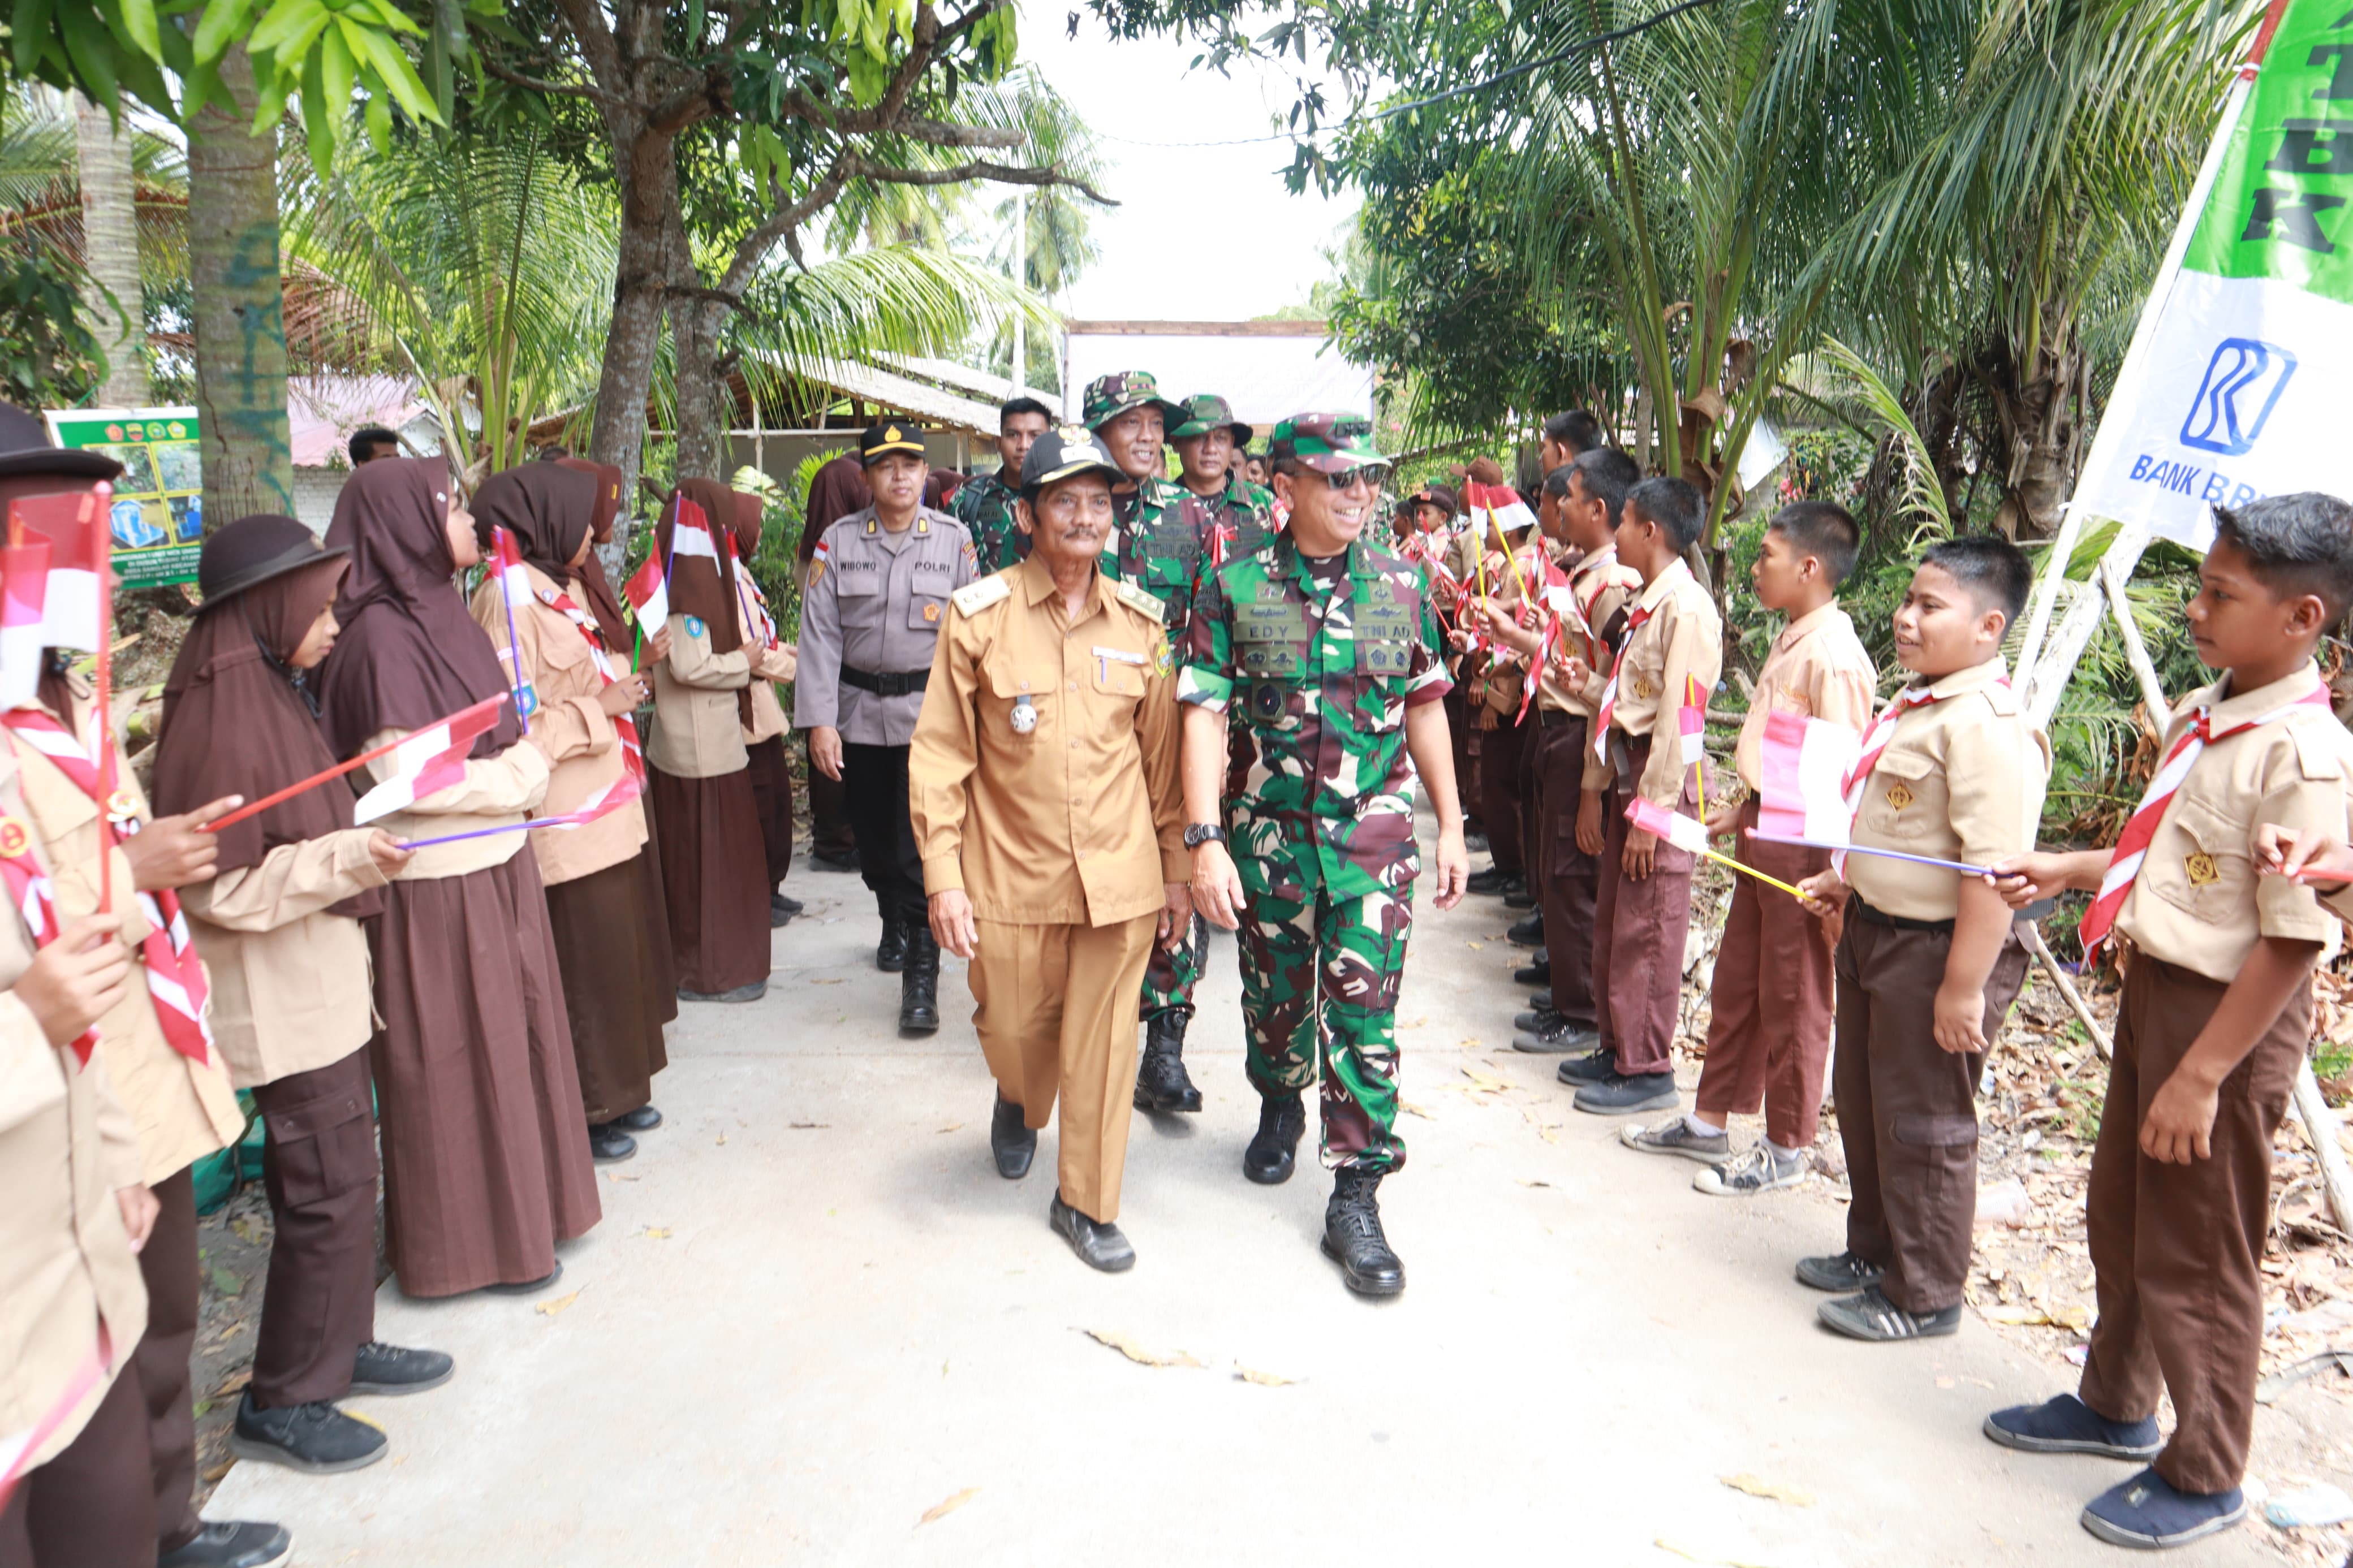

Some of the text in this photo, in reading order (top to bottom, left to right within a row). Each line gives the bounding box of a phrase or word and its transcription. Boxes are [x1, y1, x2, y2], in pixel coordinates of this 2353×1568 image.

[2130, 455, 2269, 510] BANK BR
[1179, 543, 1196, 556] AD
[840, 561, 877, 572] WIBOWO
[915, 561, 950, 573] POLRI
[1249, 626, 1290, 638] EDY
[1360, 625, 1410, 638] TNI AD
